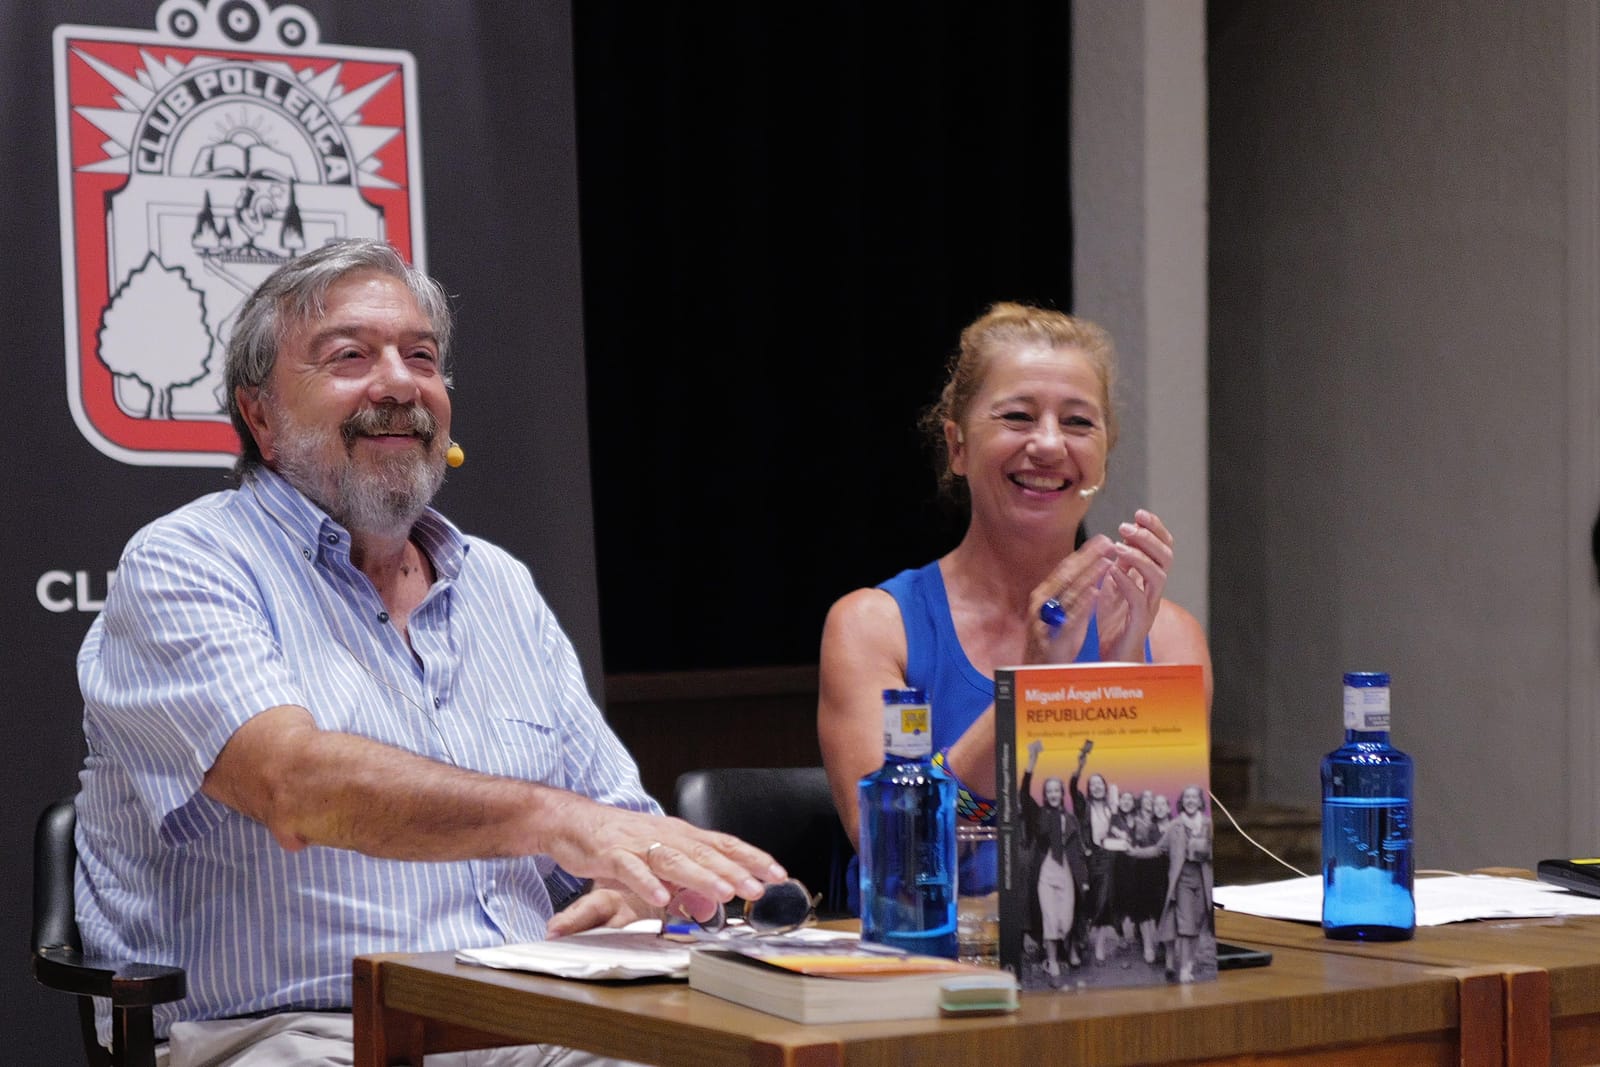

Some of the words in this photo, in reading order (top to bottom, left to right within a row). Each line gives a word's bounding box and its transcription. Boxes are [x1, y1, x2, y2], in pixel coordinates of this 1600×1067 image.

[138, 84, 195, 172] CLUB
[194, 68, 350, 182] POLLENÇA
[1025, 687, 1065, 704] Miguel
[1067, 685, 1101, 703] Ángel
[1103, 685, 1144, 700] Villena
[1026, 706, 1138, 723] REPUBLICANAS
